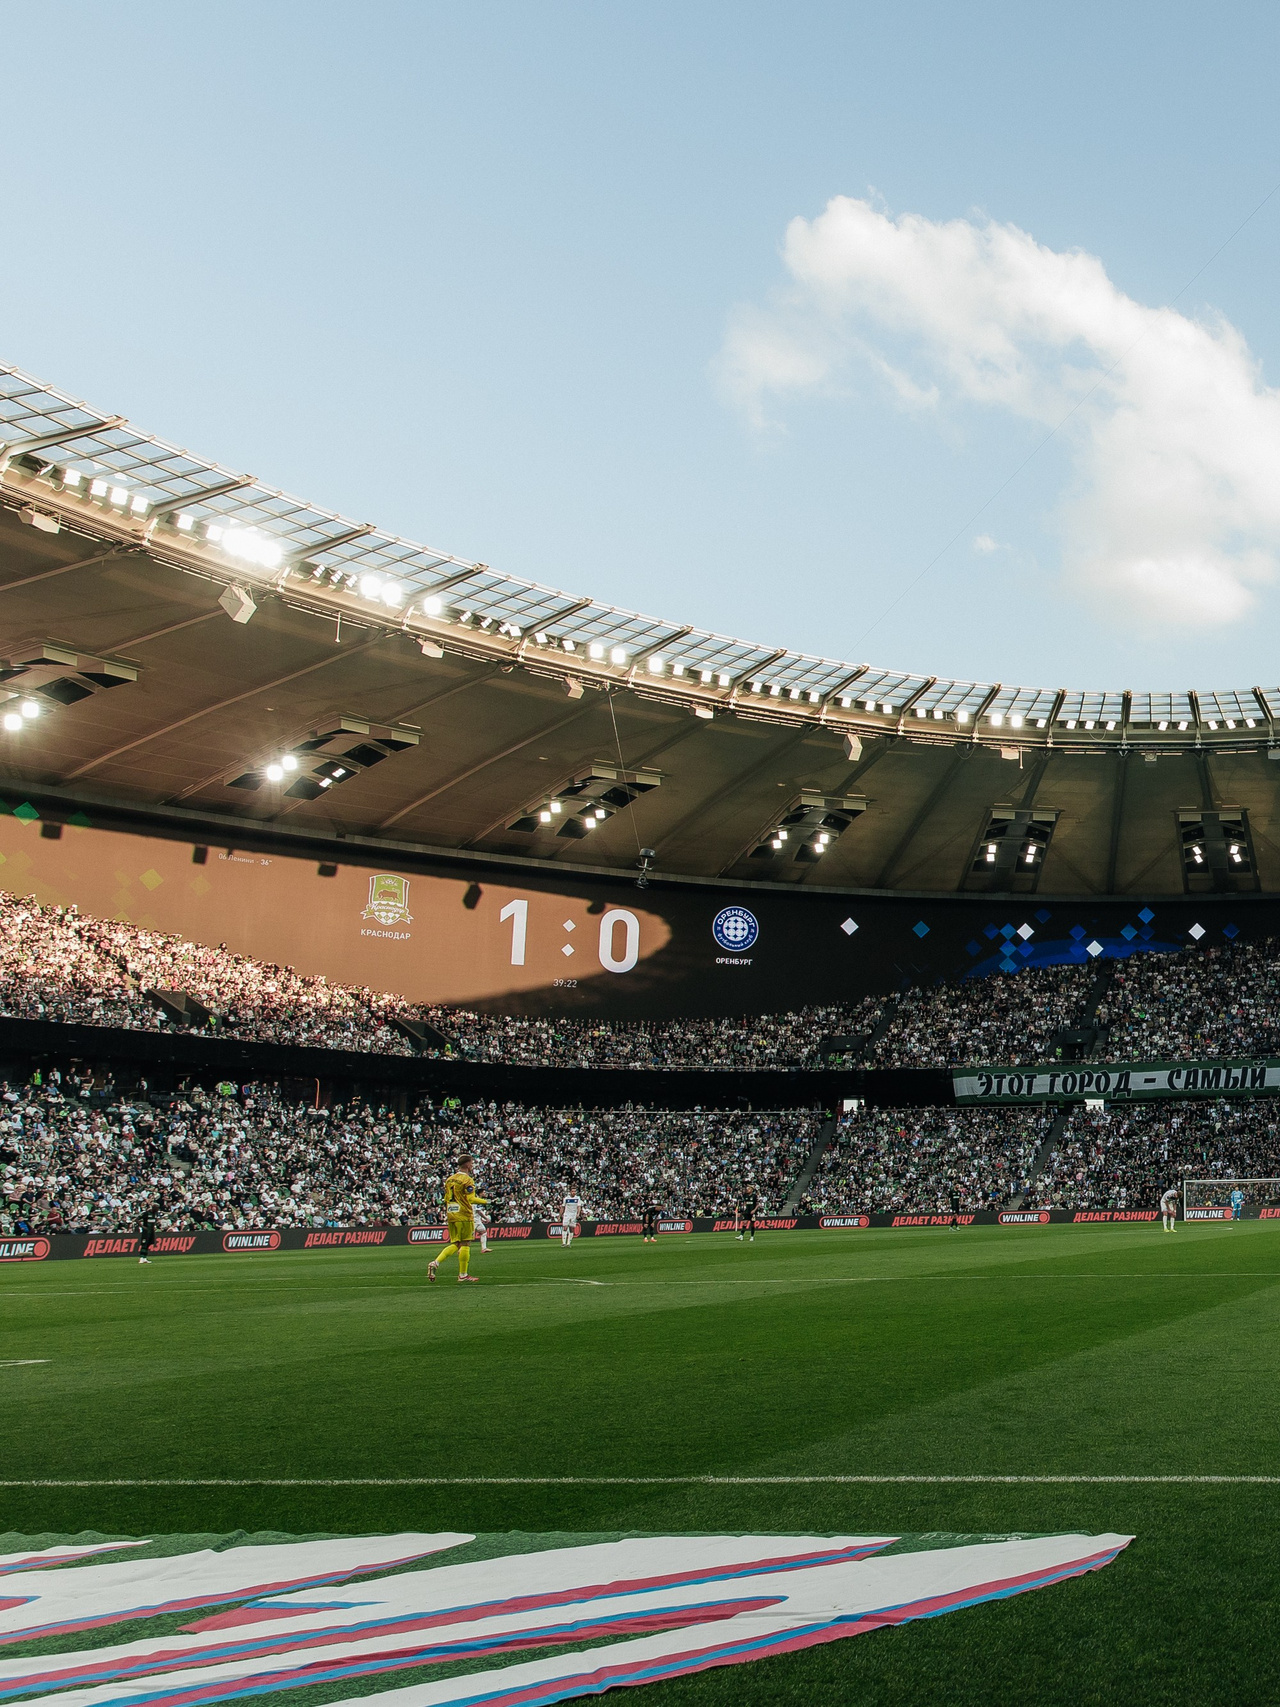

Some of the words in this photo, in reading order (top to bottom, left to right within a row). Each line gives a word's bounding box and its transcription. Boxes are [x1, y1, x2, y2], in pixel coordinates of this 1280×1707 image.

[717, 909, 755, 928] ОРЕНБУРГ
[360, 928, 411, 940] КРАСНОДАР
[715, 957, 753, 966] ОРЕНБУРГ
[553, 978, 578, 988] 39:22
[977, 1071, 1038, 1098] ЭТОТ
[1048, 1069, 1132, 1099] ГОРОД
[1166, 1060, 1268, 1092] САМЫЙ
[1001, 1213, 1039, 1223] WINLINE
[1073, 1211, 1113, 1223] ДЕЛАЕТ
[1112, 1210, 1159, 1222] РАЗНИЦУ
[1186, 1210, 1224, 1219] WINLINE
[659, 1222, 685, 1231] WINLINE
[823, 1217, 859, 1227] WINLINE
[891, 1215, 930, 1227] ДЕЛАЕТ
[411, 1229, 443, 1241] WINLINE
[499, 1226, 532, 1239] РАЗНИЦУ
[595, 1224, 619, 1236] ДЕЛАЕТ
[228, 1235, 270, 1248] WINLINE
[304, 1232, 345, 1248] ДЕЛАЕТ
[344, 1230, 387, 1245] РАЗНИЦУ
[83, 1238, 138, 1257] ДЕЛАЕТ
